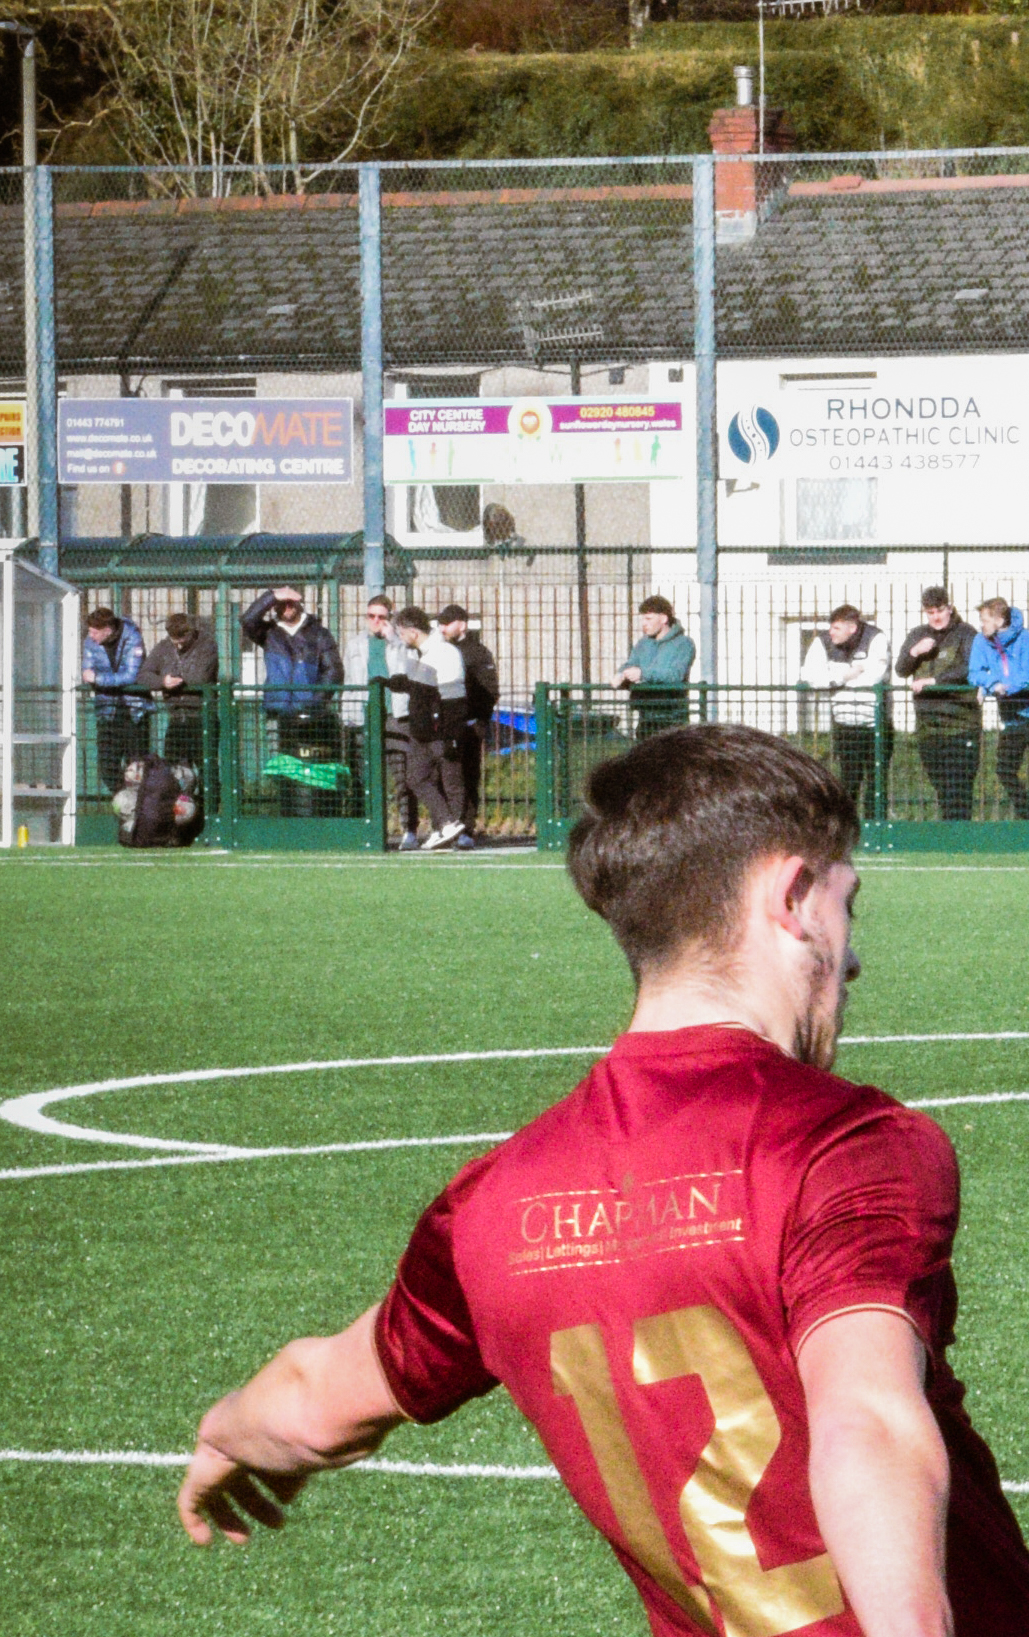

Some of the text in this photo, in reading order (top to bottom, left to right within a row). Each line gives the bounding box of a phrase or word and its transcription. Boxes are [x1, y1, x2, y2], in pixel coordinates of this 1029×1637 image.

[410, 408, 484, 421] CITY CENTRE
[827, 397, 981, 420] RHONDDA
[170, 411, 343, 447] DECOMATE
[408, 420, 486, 433] DAY NURSERY
[790, 426, 1020, 447] OSTEOPATHIC CLINIC
[67, 463, 110, 473] Find us on
[172, 458, 345, 475] DECORATING CENTRE
[829, 454, 981, 470] 01443 438577
